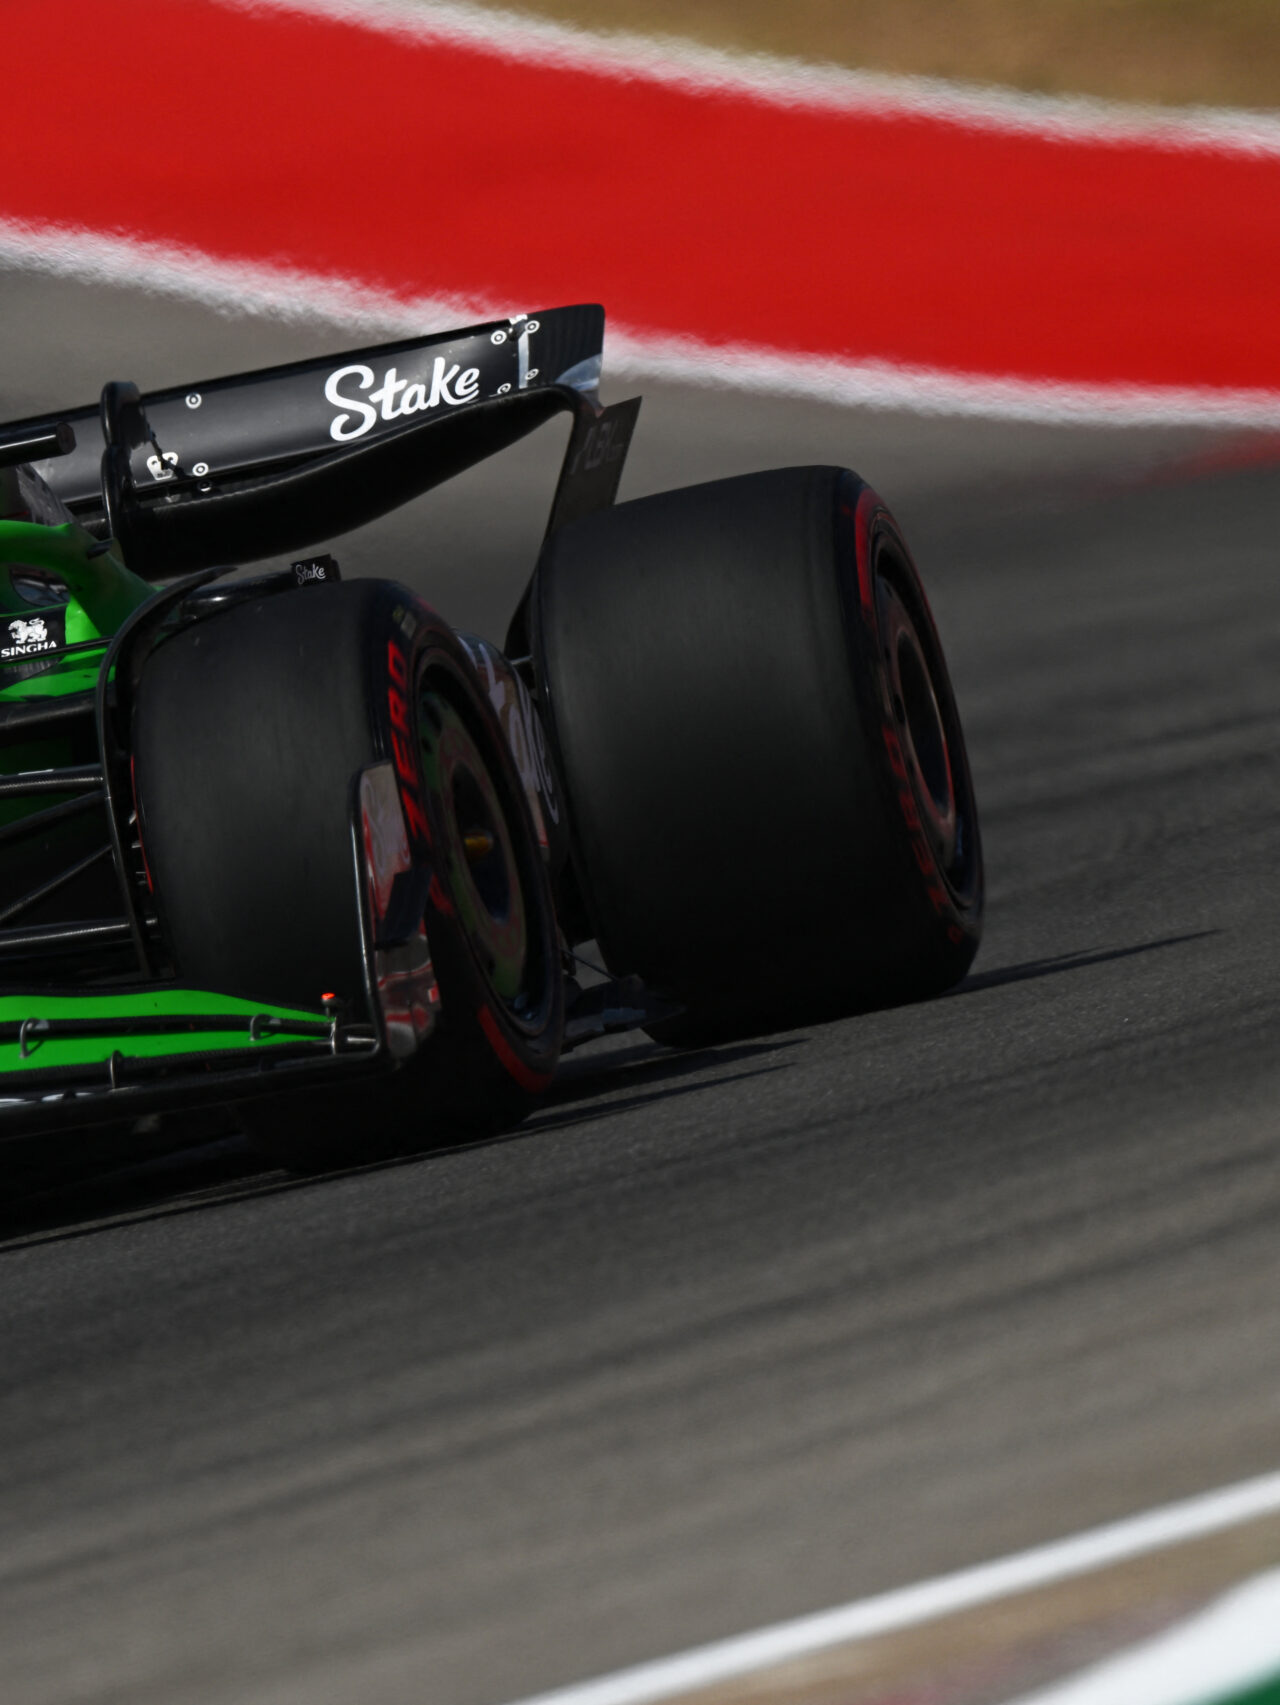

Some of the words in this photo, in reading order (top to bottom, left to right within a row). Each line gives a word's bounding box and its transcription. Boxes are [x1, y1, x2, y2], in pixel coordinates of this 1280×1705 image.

[324, 357, 481, 442] Stake
[295, 563, 327, 585] Stake
[0, 640, 57, 658] SINGHA
